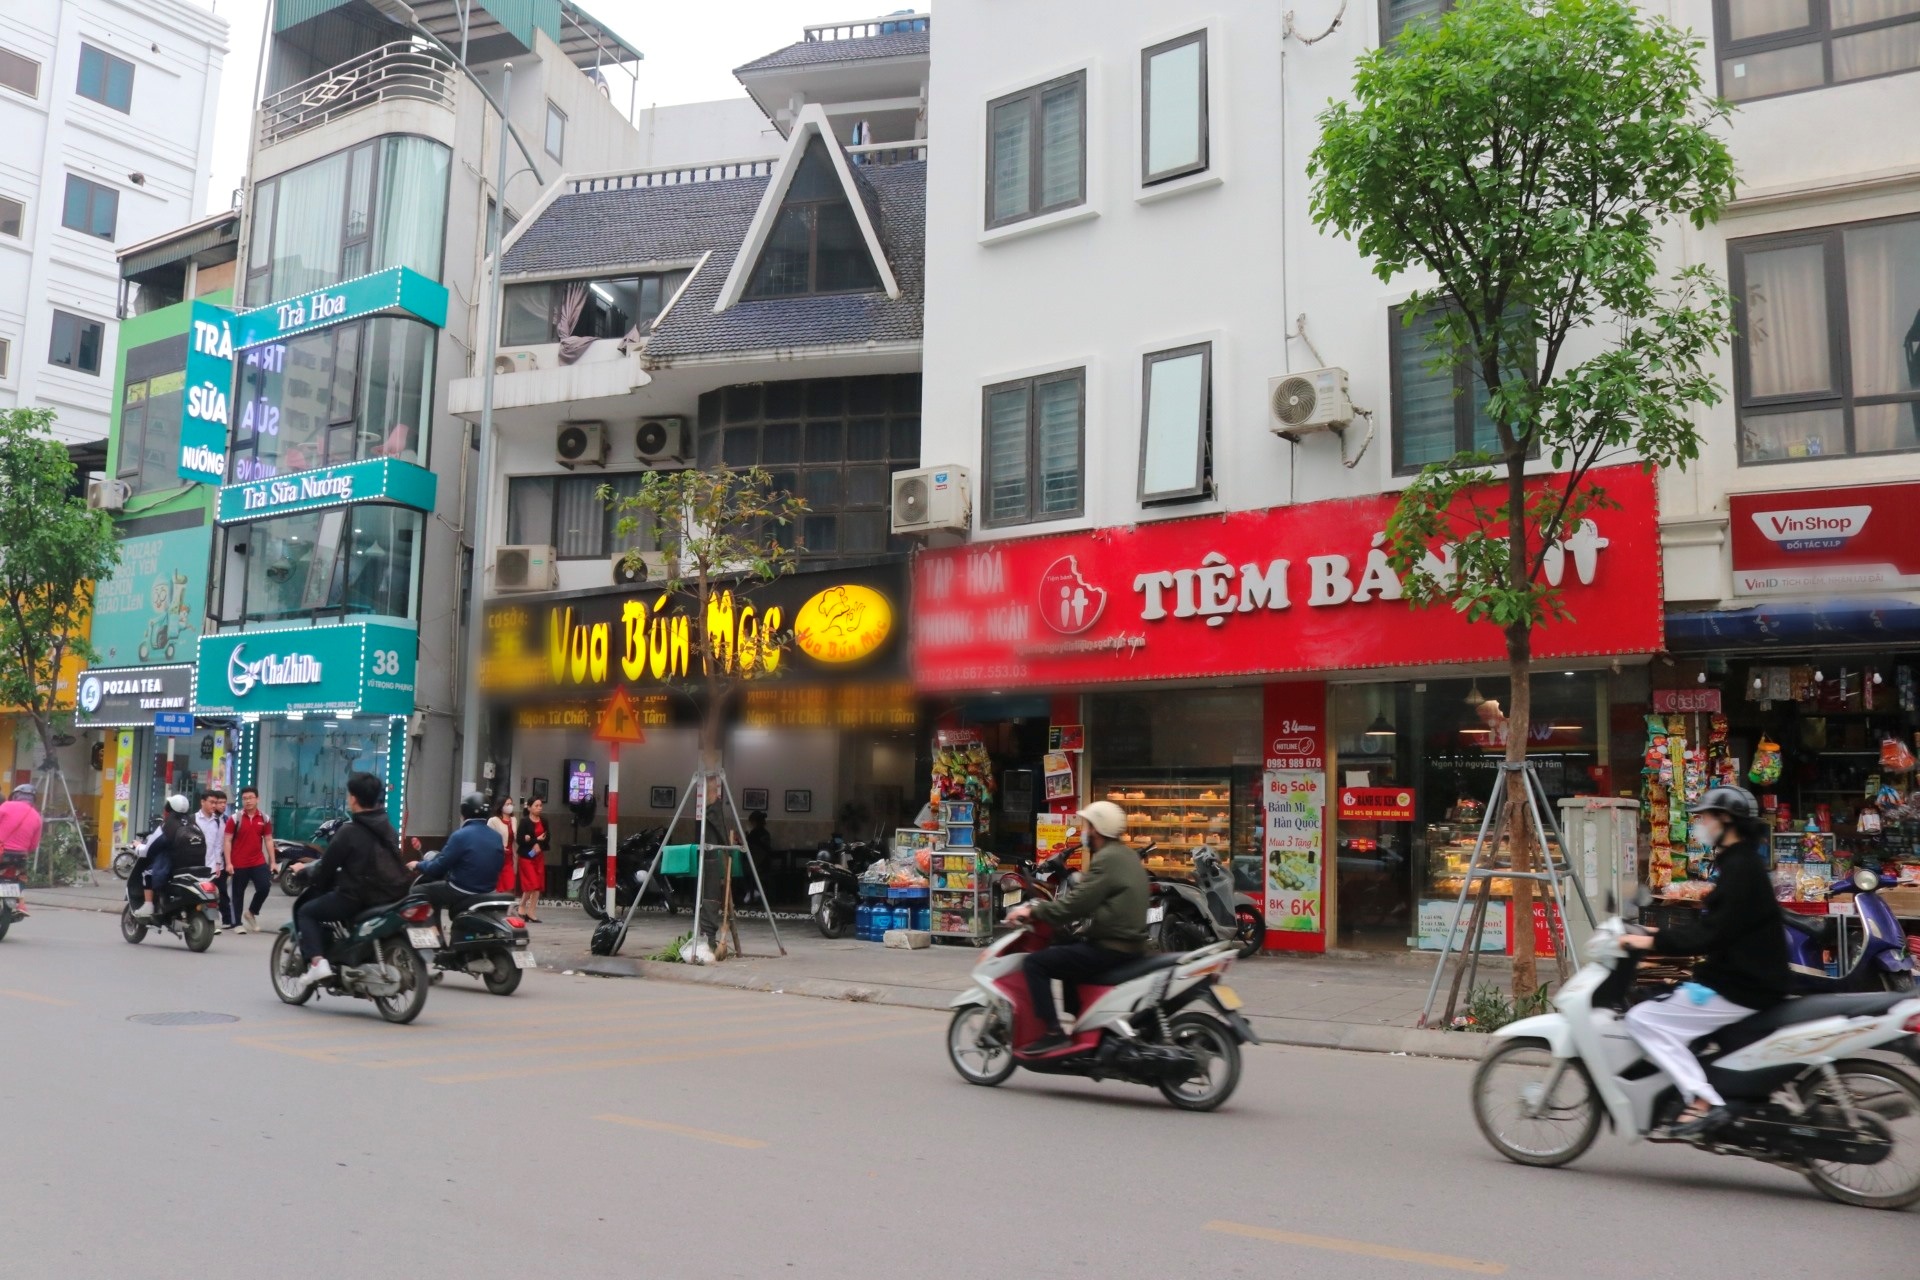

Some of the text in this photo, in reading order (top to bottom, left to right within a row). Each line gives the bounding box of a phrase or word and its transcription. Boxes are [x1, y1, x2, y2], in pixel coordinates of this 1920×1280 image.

[277, 293, 346, 330] Trà Hoa
[194, 320, 233, 361] TRÀ
[187, 381, 227, 425] SỮA
[182, 444, 225, 475] NƯỚNG
[243, 472, 352, 510] Trà Sữa Nướng
[1771, 516, 1851, 534] VinShop
[1786, 540, 1842, 550] ĐỐI TÁC V.I.P
[1133, 551, 1292, 627] TIỆM
[551, 606, 608, 685] Vua
[621, 594, 690, 681] Bún
[261, 653, 322, 685] ChaZhiDu
[372, 649, 399, 675] 38
[102, 678, 163, 695] POZAA TEA
[140, 697, 159, 709] TAKE
[160, 697, 185, 708] AWAY
[1282, 720, 1298, 734] 34
[1305, 757, 1322, 768] 678
[1431, 760, 1453, 769] Ngon
[1271, 780, 1317, 794] Big Sale
[1268, 801, 1292, 813] Bánh
[1273, 816, 1320, 831] Hàn Quốc
[1269, 838, 1285, 847] Mua
[1287, 836, 1293, 847] 3
[1269, 898, 1316, 917] 8K 6K
